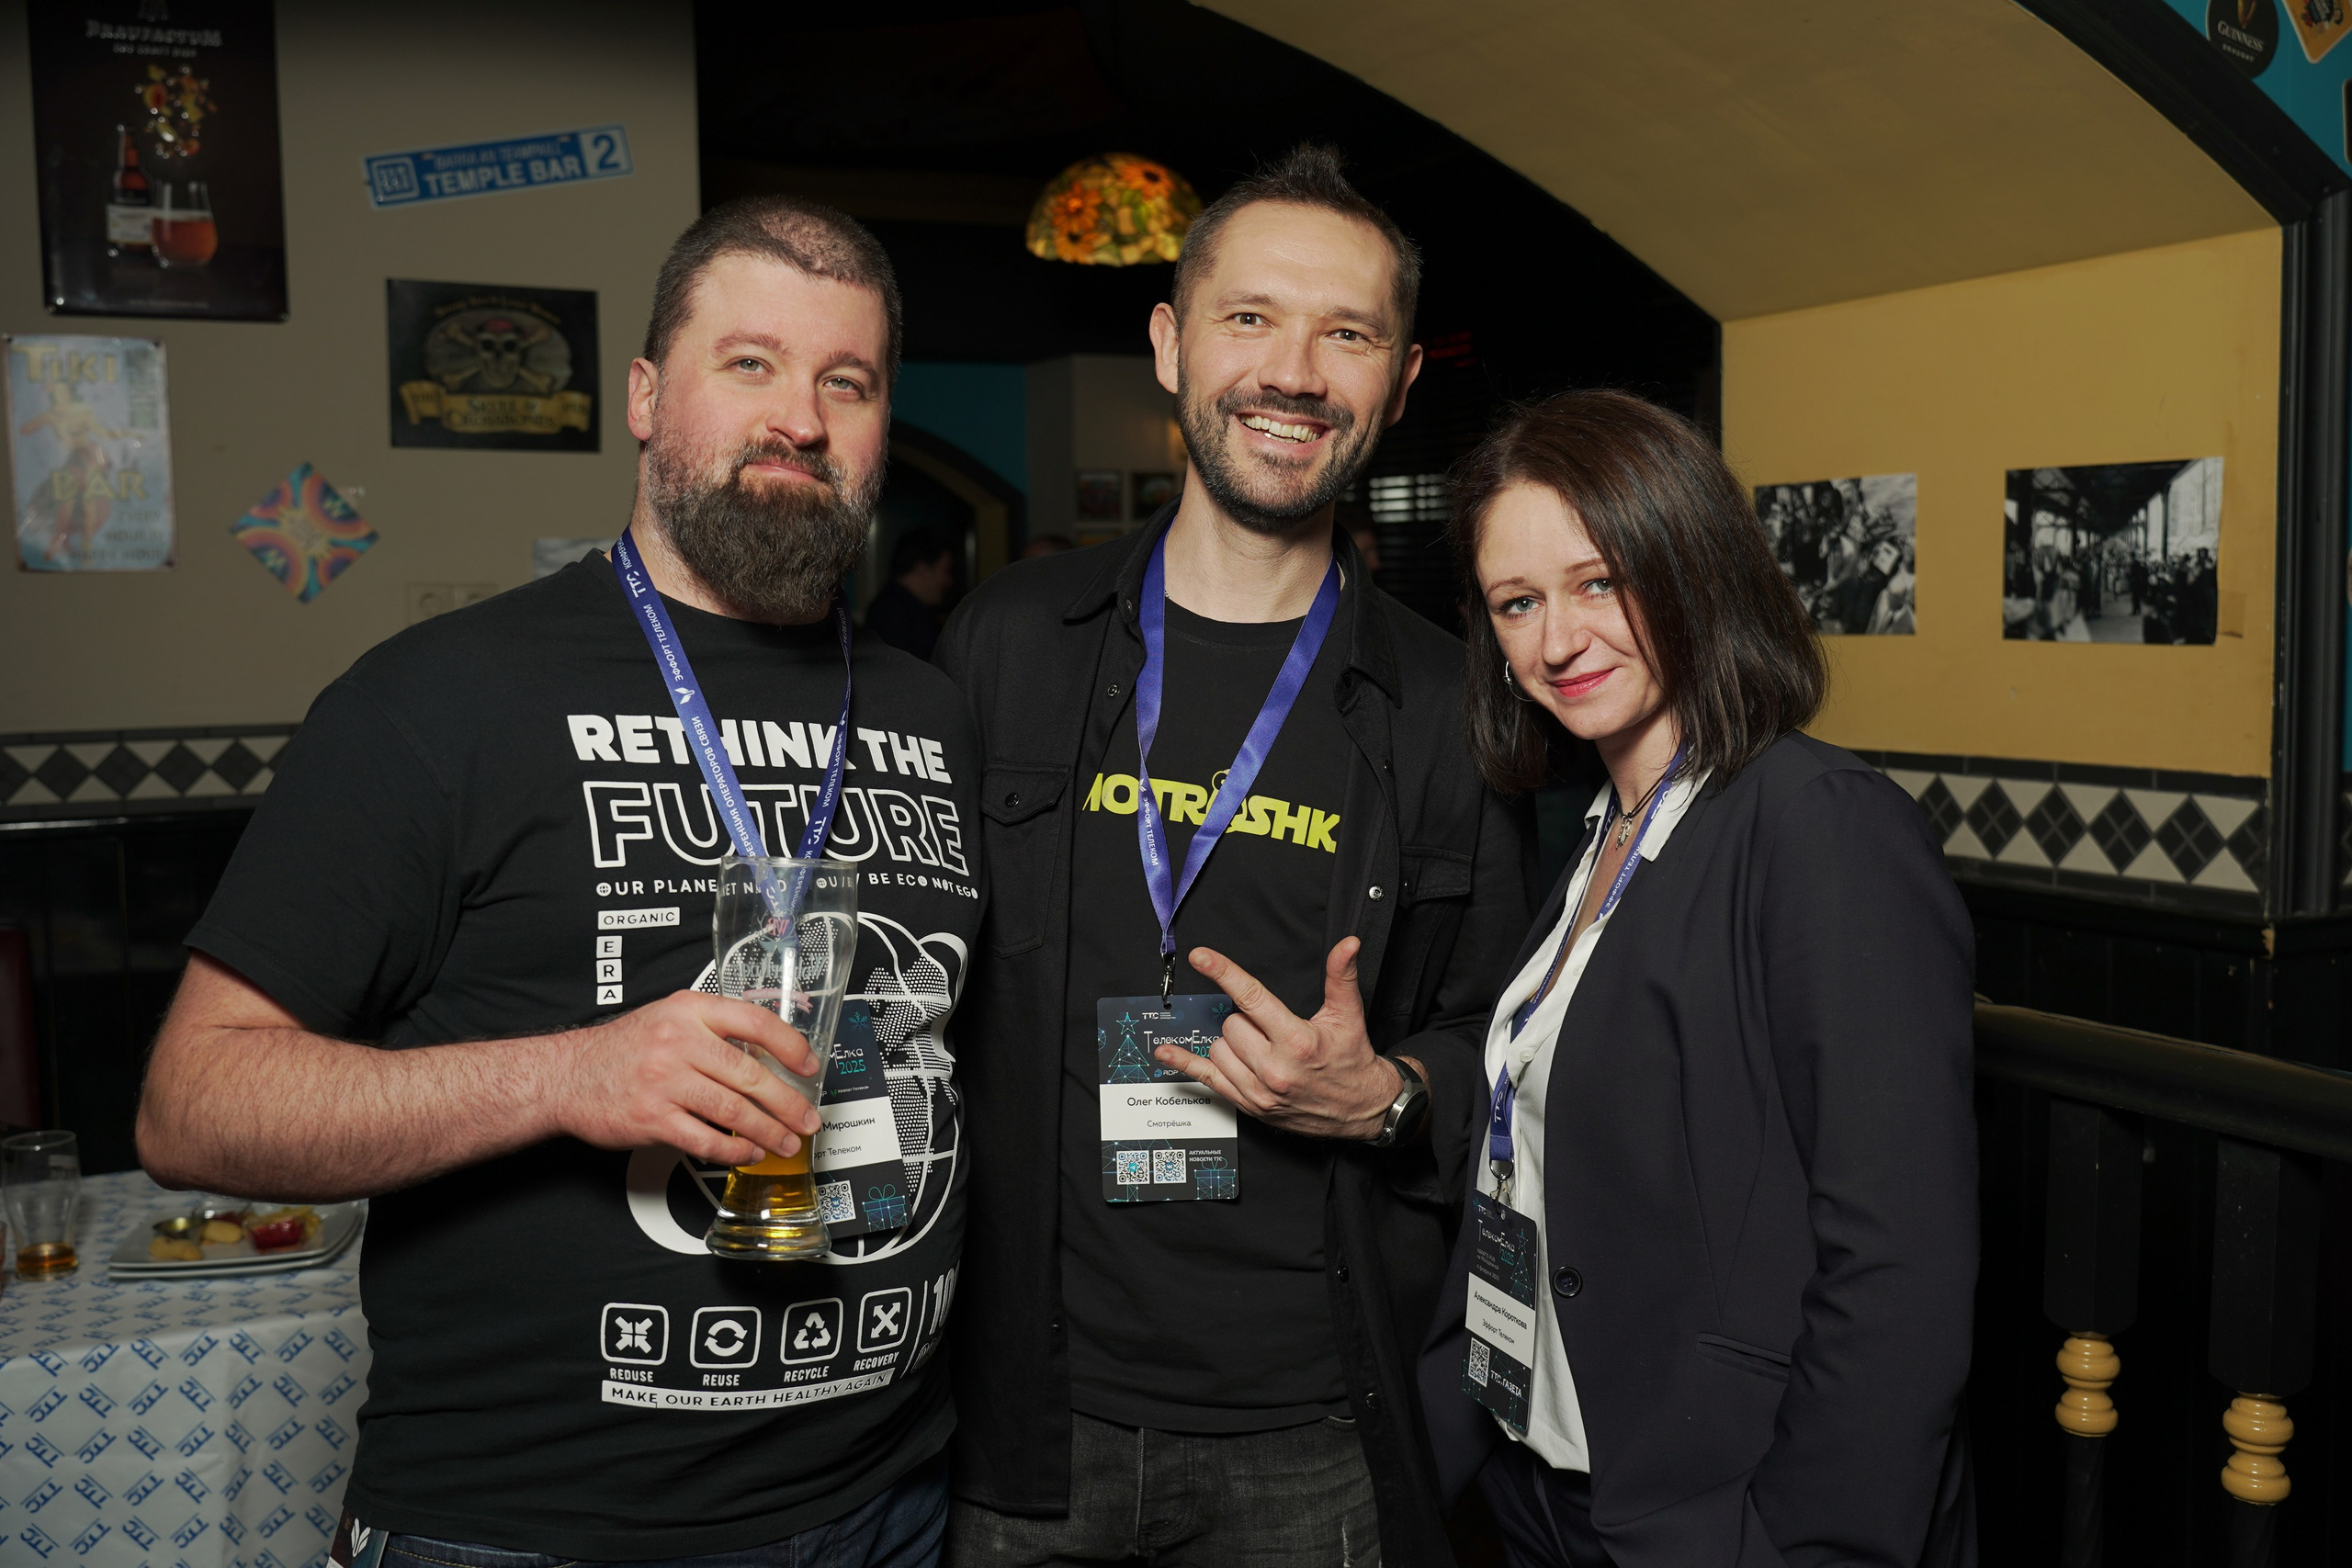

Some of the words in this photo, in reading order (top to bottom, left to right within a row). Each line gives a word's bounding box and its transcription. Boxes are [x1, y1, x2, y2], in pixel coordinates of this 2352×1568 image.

[2217, 19, 2266, 53] GUINNESS
[423, 163, 528, 197] TEMPLE
[529, 154, 582, 184] BAR
[593, 134, 620, 171] 2
[643, 604, 667, 643] ТЕЛЕКОМ
[662, 644, 684, 682] ЭФФОРТ
[691, 716, 710, 746] СВЯЗИ
[857, 727, 953, 784] THE
[704, 747, 734, 810] ОПЕРАТОРОВ
[822, 768, 838, 807] ТЕЛЕКОМ
[582, 781, 970, 877] FUTURE
[1142, 797, 1152, 829] ЭФФОРТ
[1146, 829, 1159, 866] ТЕЛЕКОМ
[868, 873, 891, 885] BE
[1606, 873, 1626, 908] ЭФФОРТ
[604, 911, 676, 926] ORGANIC
[838, 1059, 866, 1075] 2025
[1127, 1097, 1153, 1108] Олег
[1155, 1096, 1211, 1106] Кобельков
[822, 1117, 876, 1133] Мирошкин
[1147, 1120, 1192, 1129] Смотрёшка
[828, 1145, 862, 1156] Телеком
[1474, 1291, 1501, 1314] Александра
[1501, 1306, 1528, 1330] Короткова
[610, 1368, 654, 1383] REDUSE
[784, 1366, 830, 1383] RECYCLE
[853, 1350, 900, 1373] RECOVERY
[611, 1387, 658, 1405] MAKE
[666, 1394, 703, 1407] OUR
[710, 1394, 766, 1407] EARTH
[773, 1383, 842, 1404] HEALTHY
[842, 1373, 888, 1393] AGAIN
[702, 1373, 741, 1387] REUSE
